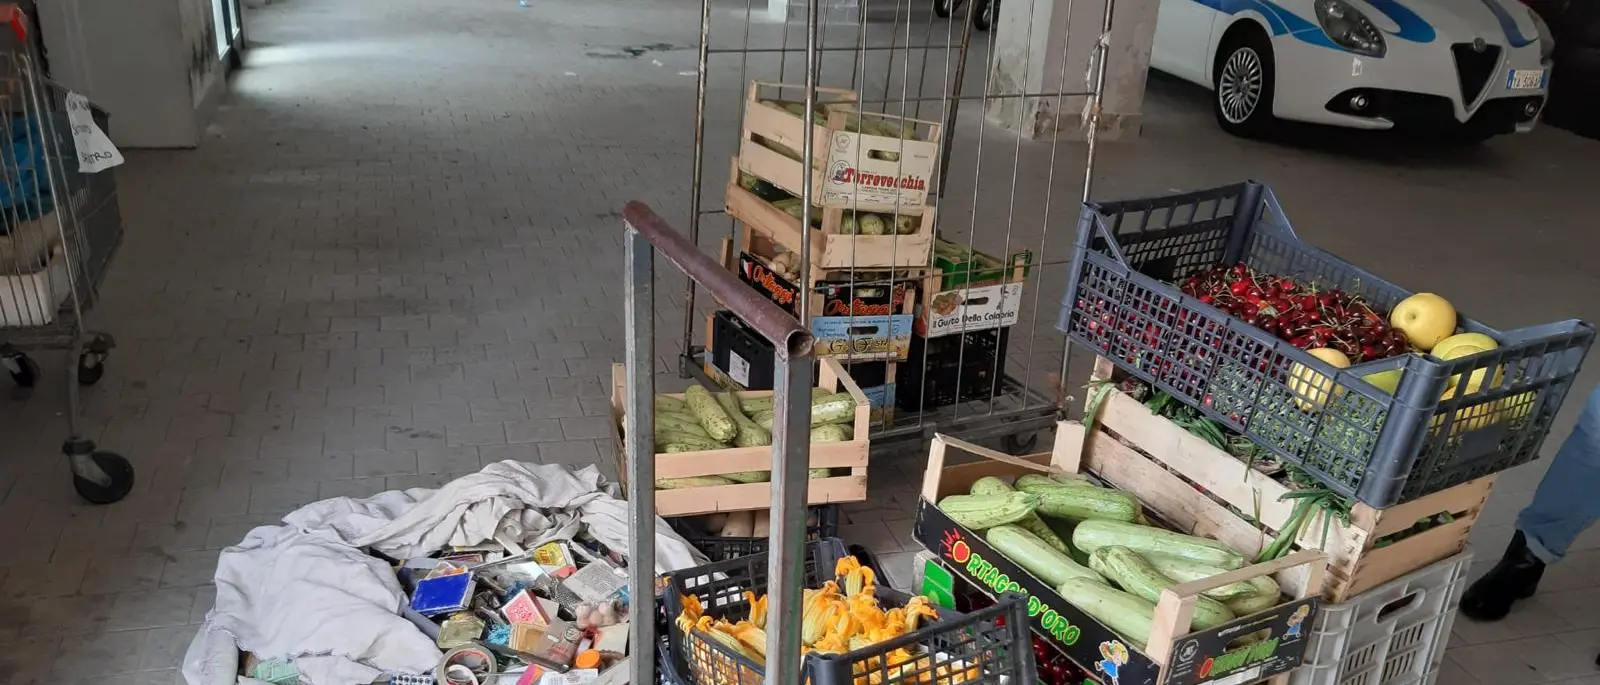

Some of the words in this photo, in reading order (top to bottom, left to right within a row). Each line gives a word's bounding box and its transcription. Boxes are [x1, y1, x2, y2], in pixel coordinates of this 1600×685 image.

[937, 316, 960, 328] Gusto
[962, 313, 982, 323] Della
[984, 310, 1015, 322] Calabria
[1027, 595, 1081, 646] D'ORO
